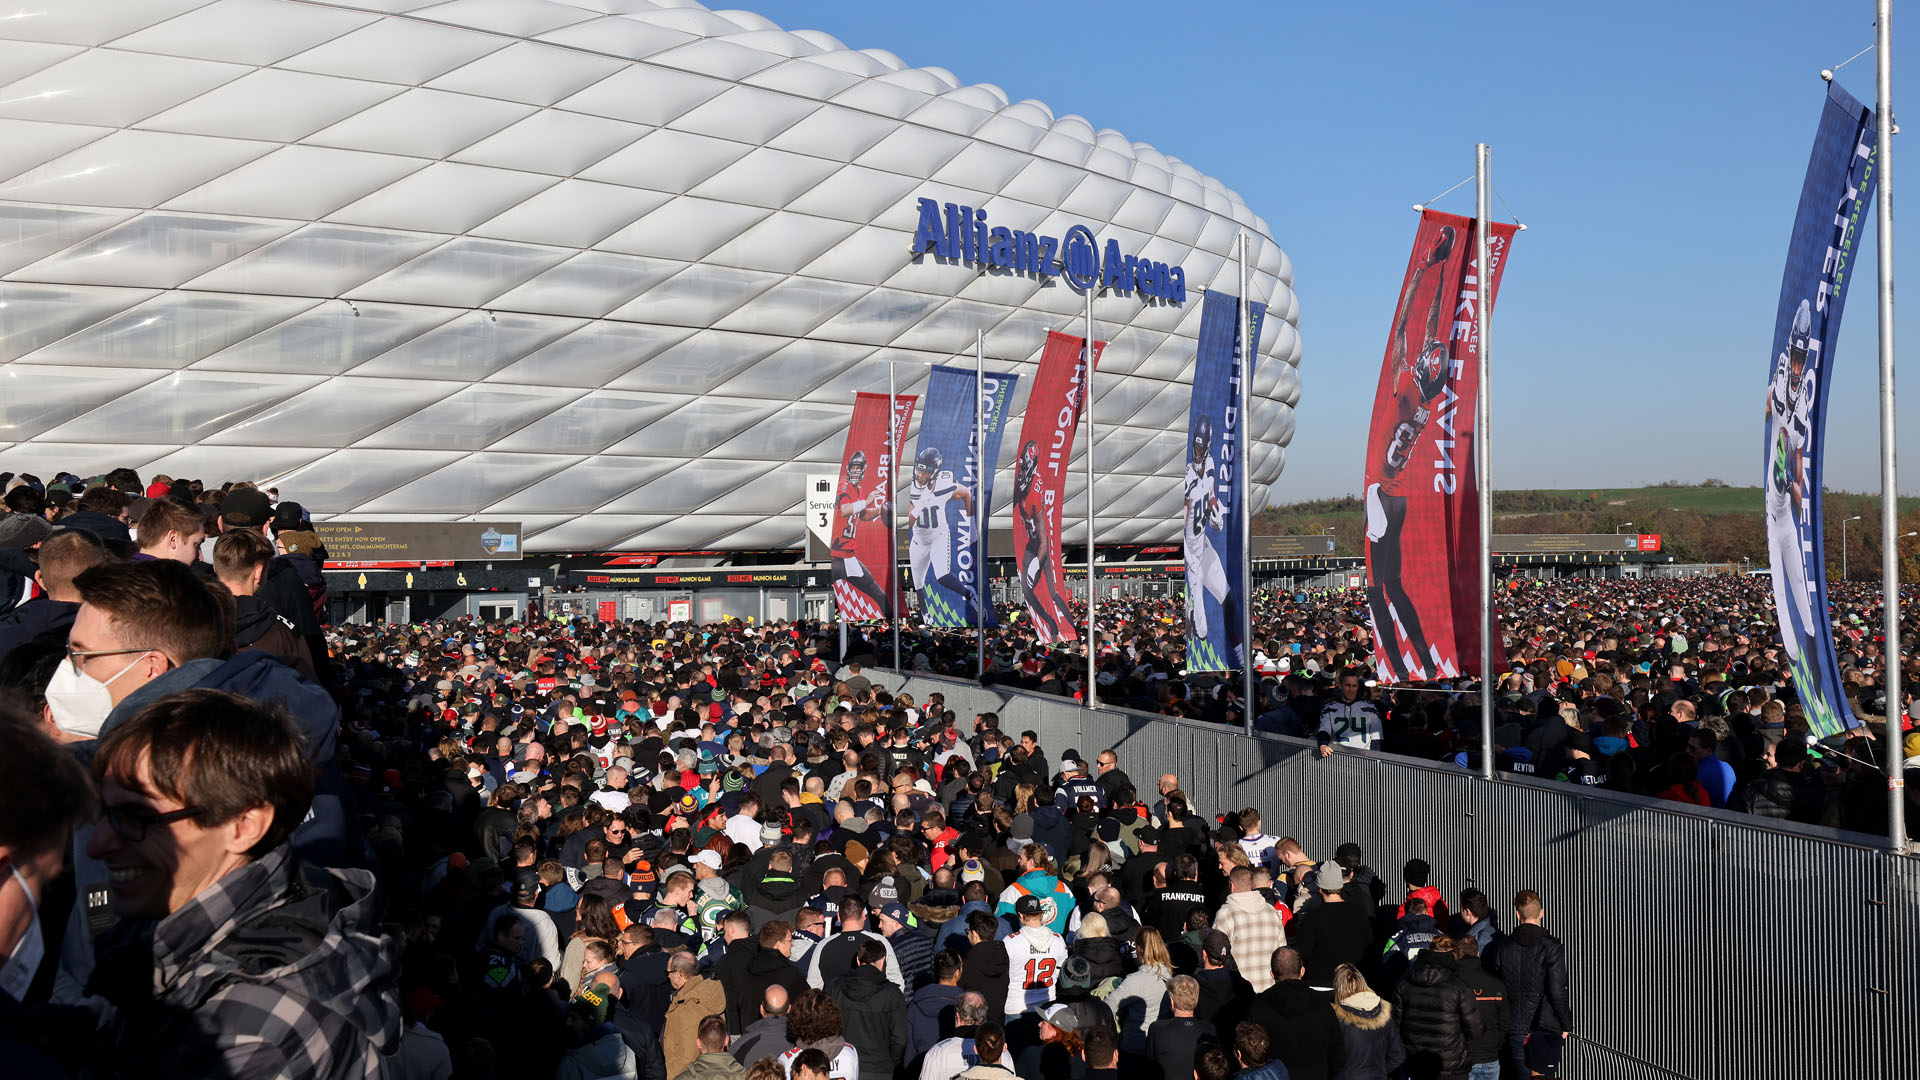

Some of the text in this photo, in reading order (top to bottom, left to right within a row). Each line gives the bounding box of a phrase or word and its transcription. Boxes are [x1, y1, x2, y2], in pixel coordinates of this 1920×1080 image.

[914, 197, 1186, 302] Allianz Arena
[809, 500, 836, 510] Servic
[819, 512, 828, 528] 3
[1333, 716, 1367, 744] 24
[1073, 785, 1097, 793] VOLLMER
[1247, 850, 1268, 858] ALLEN
[1161, 892, 1205, 903] FRANKFURT
[1022, 958, 1057, 990] 12
